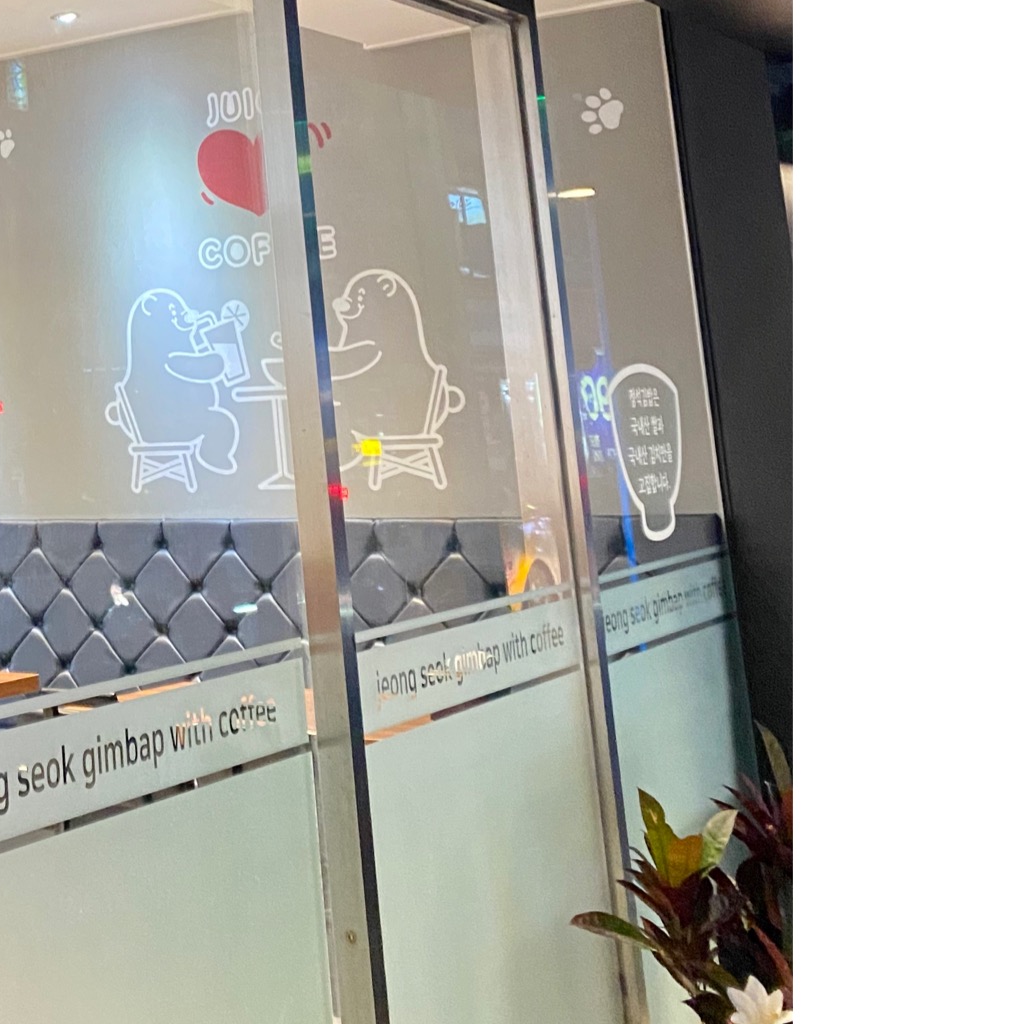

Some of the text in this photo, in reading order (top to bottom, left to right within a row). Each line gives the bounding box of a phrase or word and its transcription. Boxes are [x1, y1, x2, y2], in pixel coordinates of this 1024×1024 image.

[206, 87, 262, 128] JUI
[376, 669, 418, 711] jeong
[454, 642, 501, 686] gimbap
[502, 632, 529, 663] with
[530, 622, 565, 654] coffee
[18, 745, 75, 797] seok
[82, 728, 165, 788] gimbap
[171, 707, 214, 752] with
[219, 694, 278, 738] coffee
